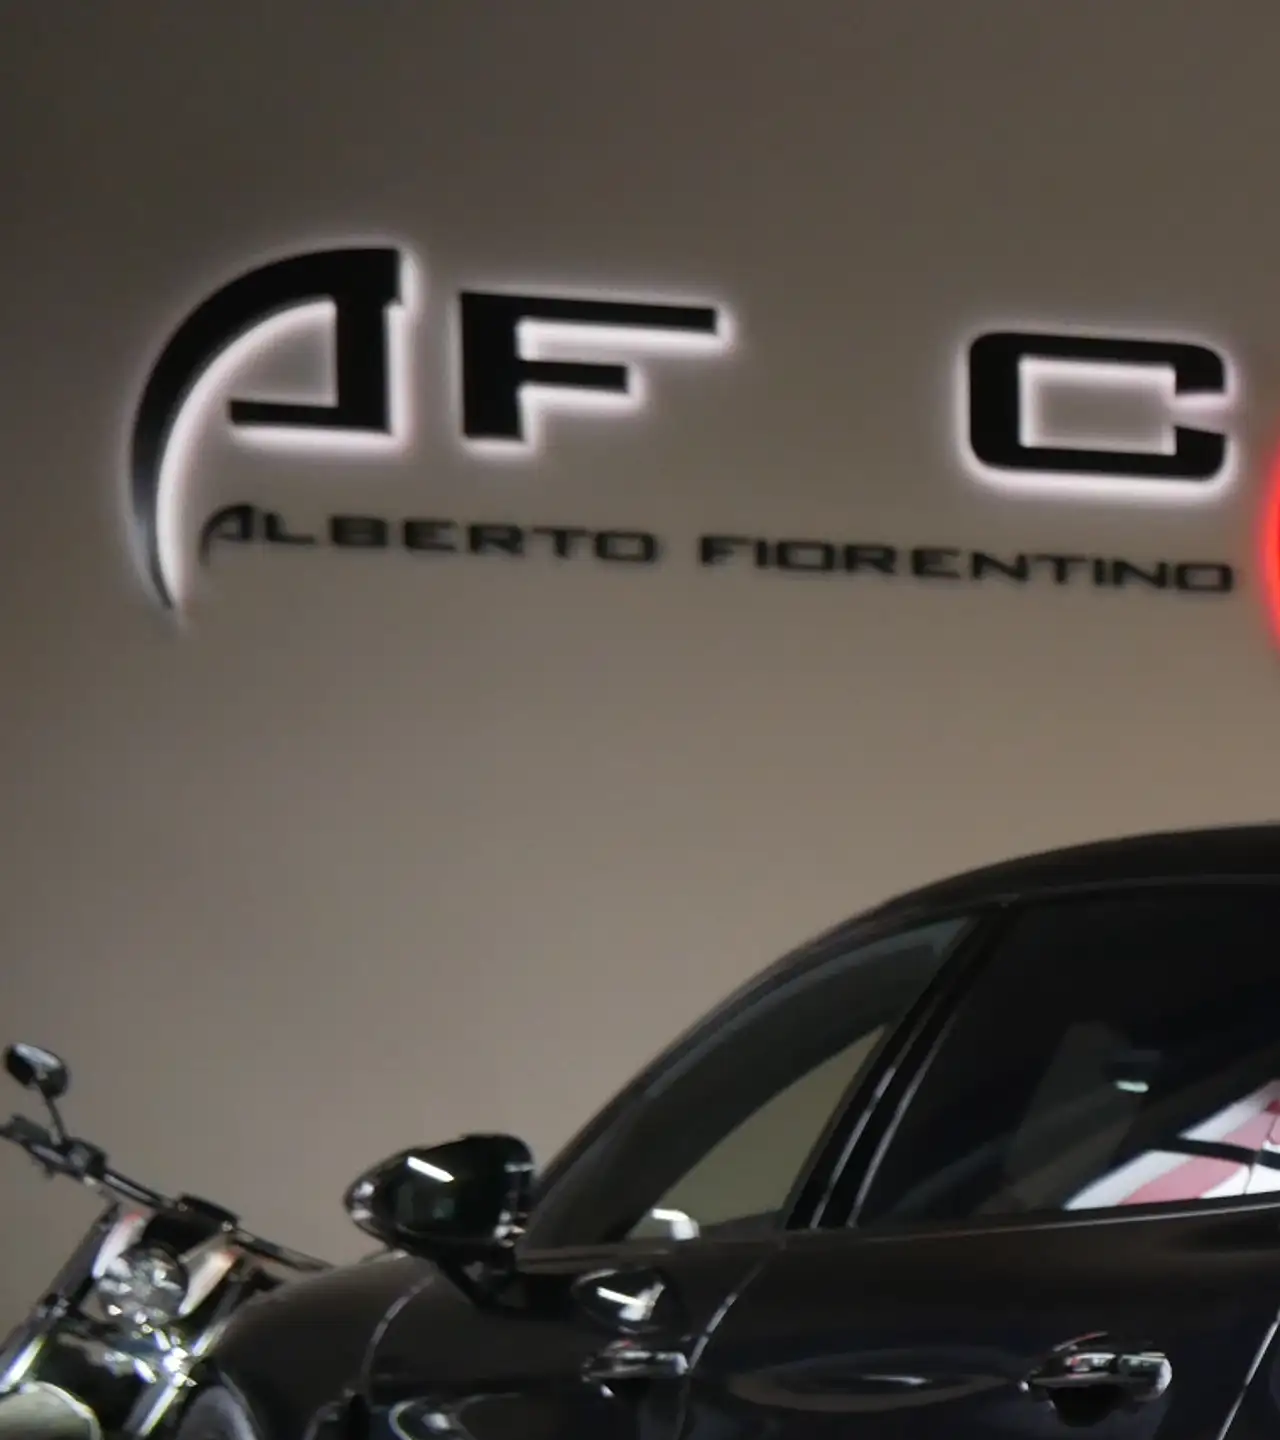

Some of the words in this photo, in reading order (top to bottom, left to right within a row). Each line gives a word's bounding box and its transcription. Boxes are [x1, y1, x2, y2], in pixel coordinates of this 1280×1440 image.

[130, 246, 716, 614] AF
[201, 504, 660, 566] ALBERTO
[699, 533, 1235, 593] FIORENTINO
